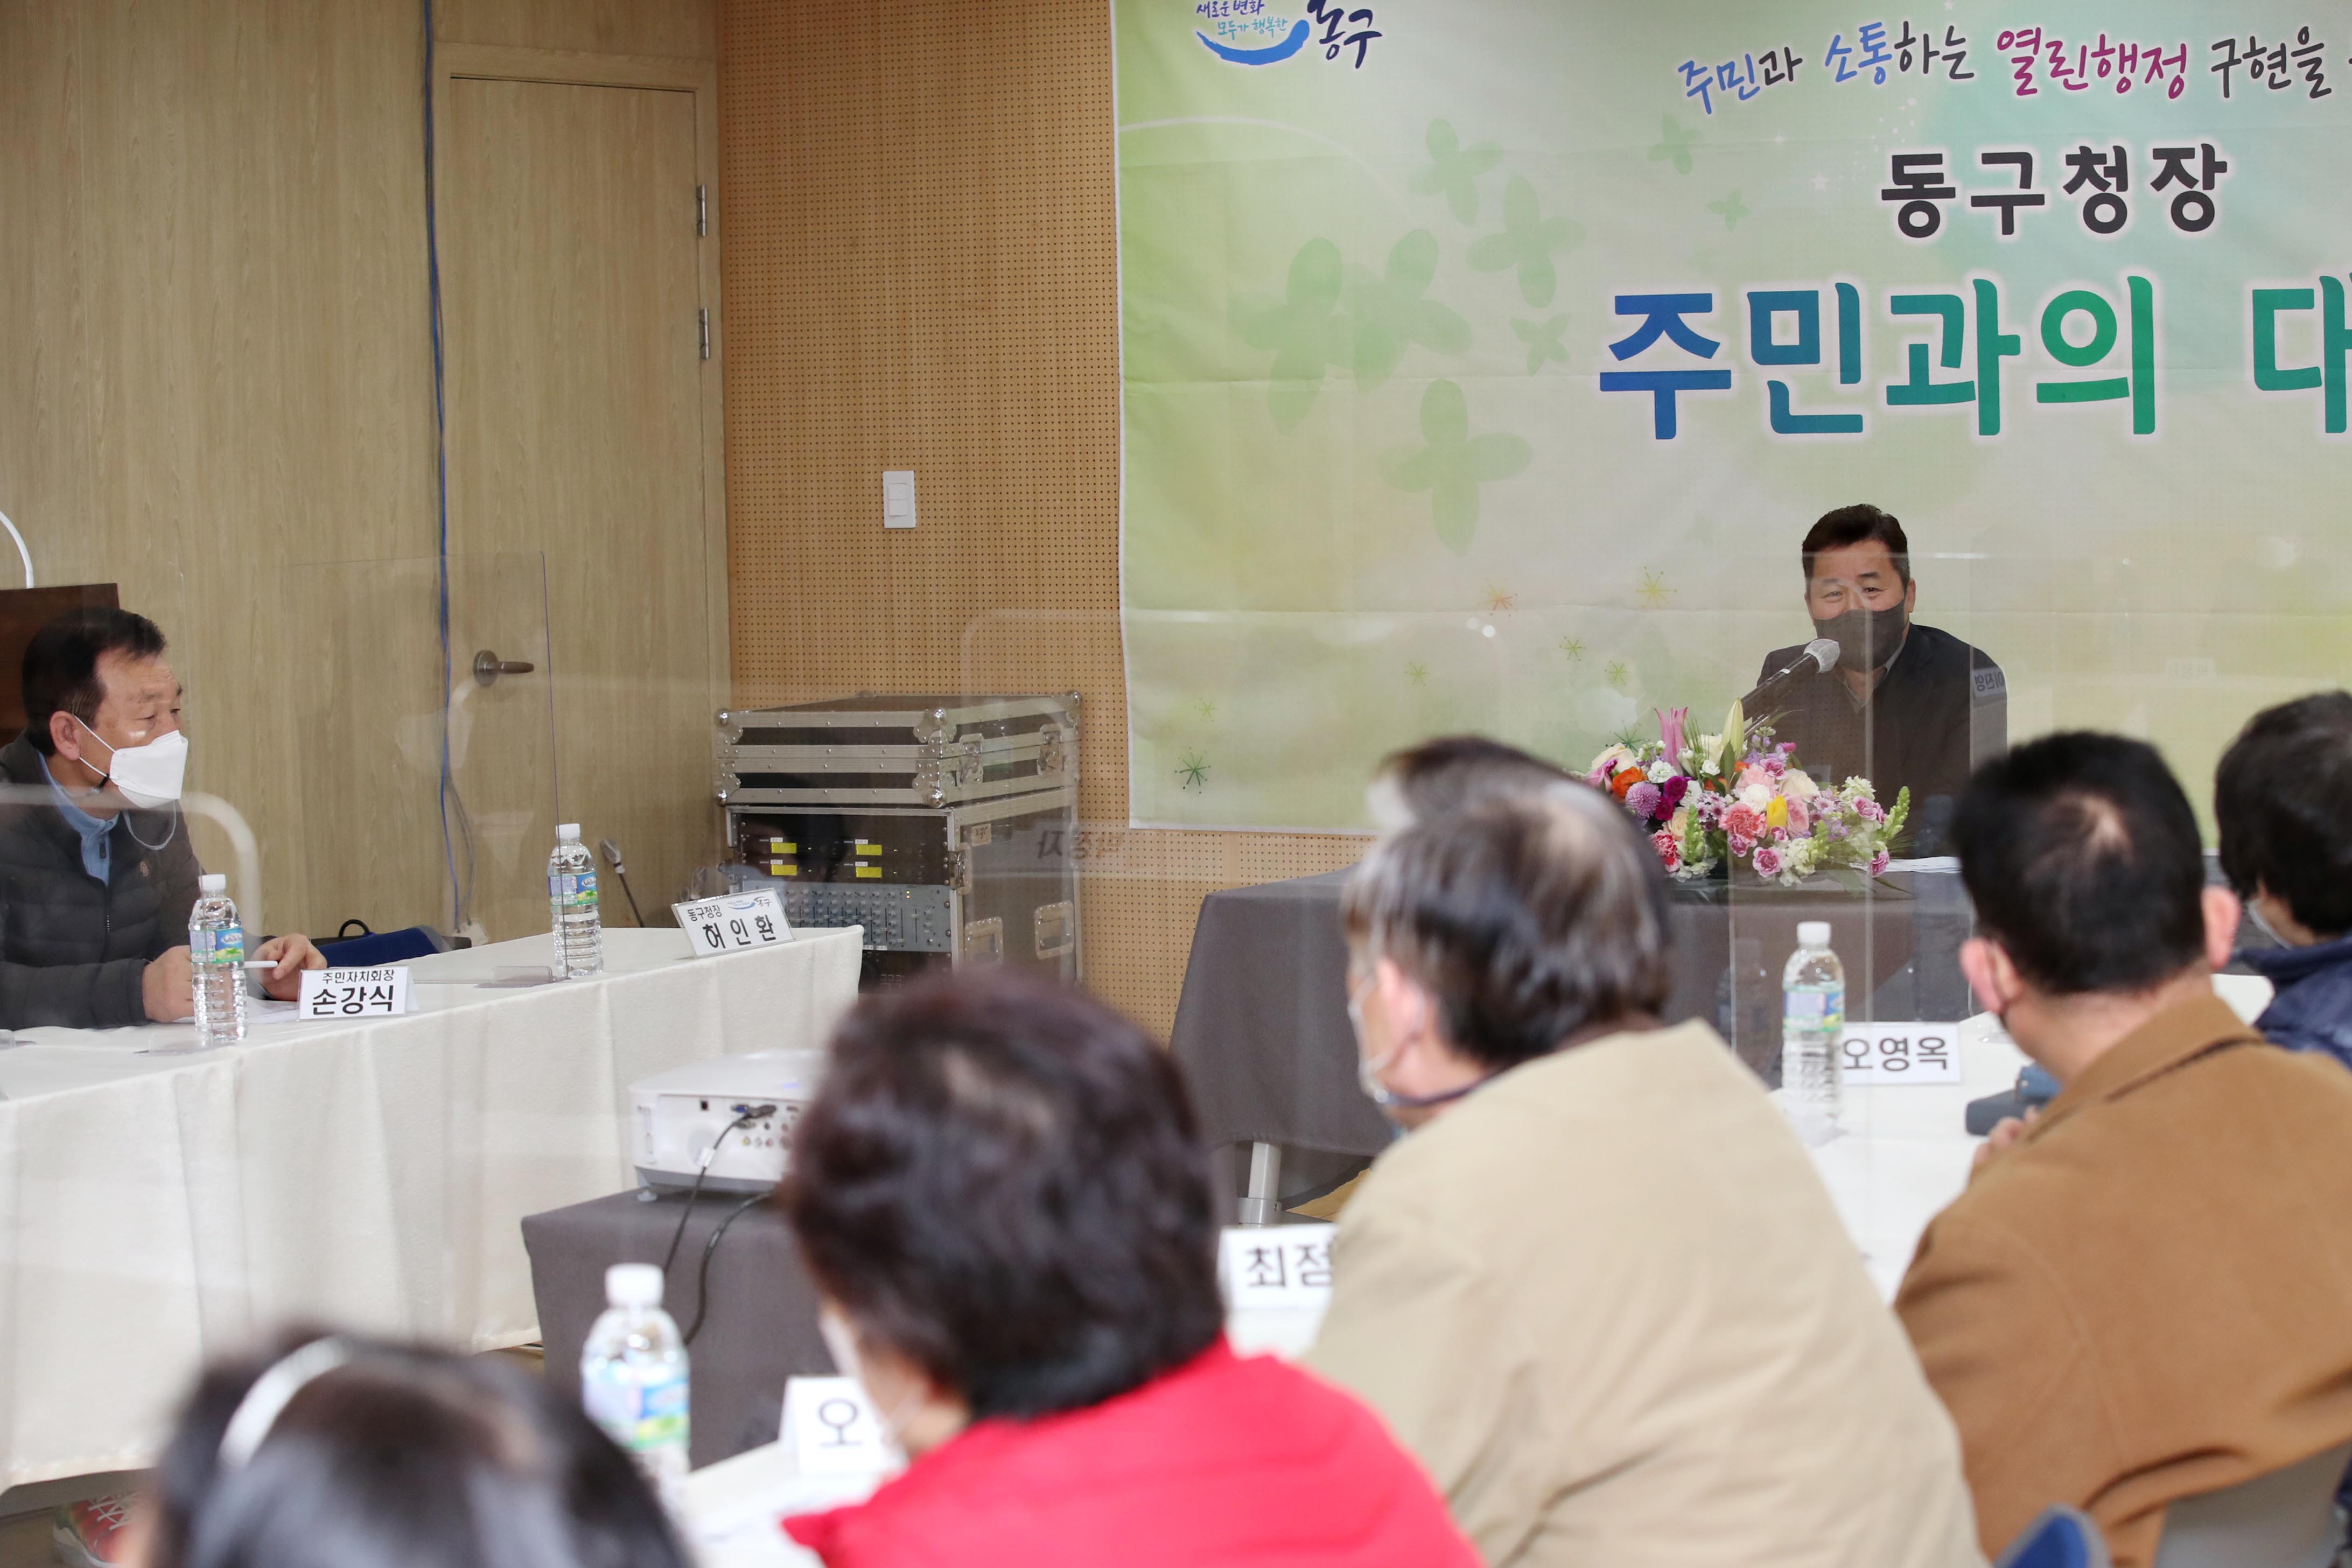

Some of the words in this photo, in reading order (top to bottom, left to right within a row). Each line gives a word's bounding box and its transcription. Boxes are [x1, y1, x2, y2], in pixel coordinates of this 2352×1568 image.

[1196, 1, 1230, 18] 새로운
[1233, 0, 1265, 16] 변화
[1217, 20, 1249, 40] 모두가
[1251, 17, 1288, 38] 행복한
[1678, 46, 1803, 115] 주민과
[1825, 21, 1975, 85] 소통하는
[1997, 27, 2187, 99] 열린행정
[2211, 26, 2332, 99] 구현을
[1881, 143, 2227, 238] 동구청장
[1600, 276, 2155, 440] 주민과의
[688, 905, 722, 921] 동구청장
[702, 914, 776, 949] 허인환
[322, 969, 395, 984] 주민자치회장
[312, 985, 393, 1015] 손강식
[1843, 1037, 1948, 1072] 오영옥
